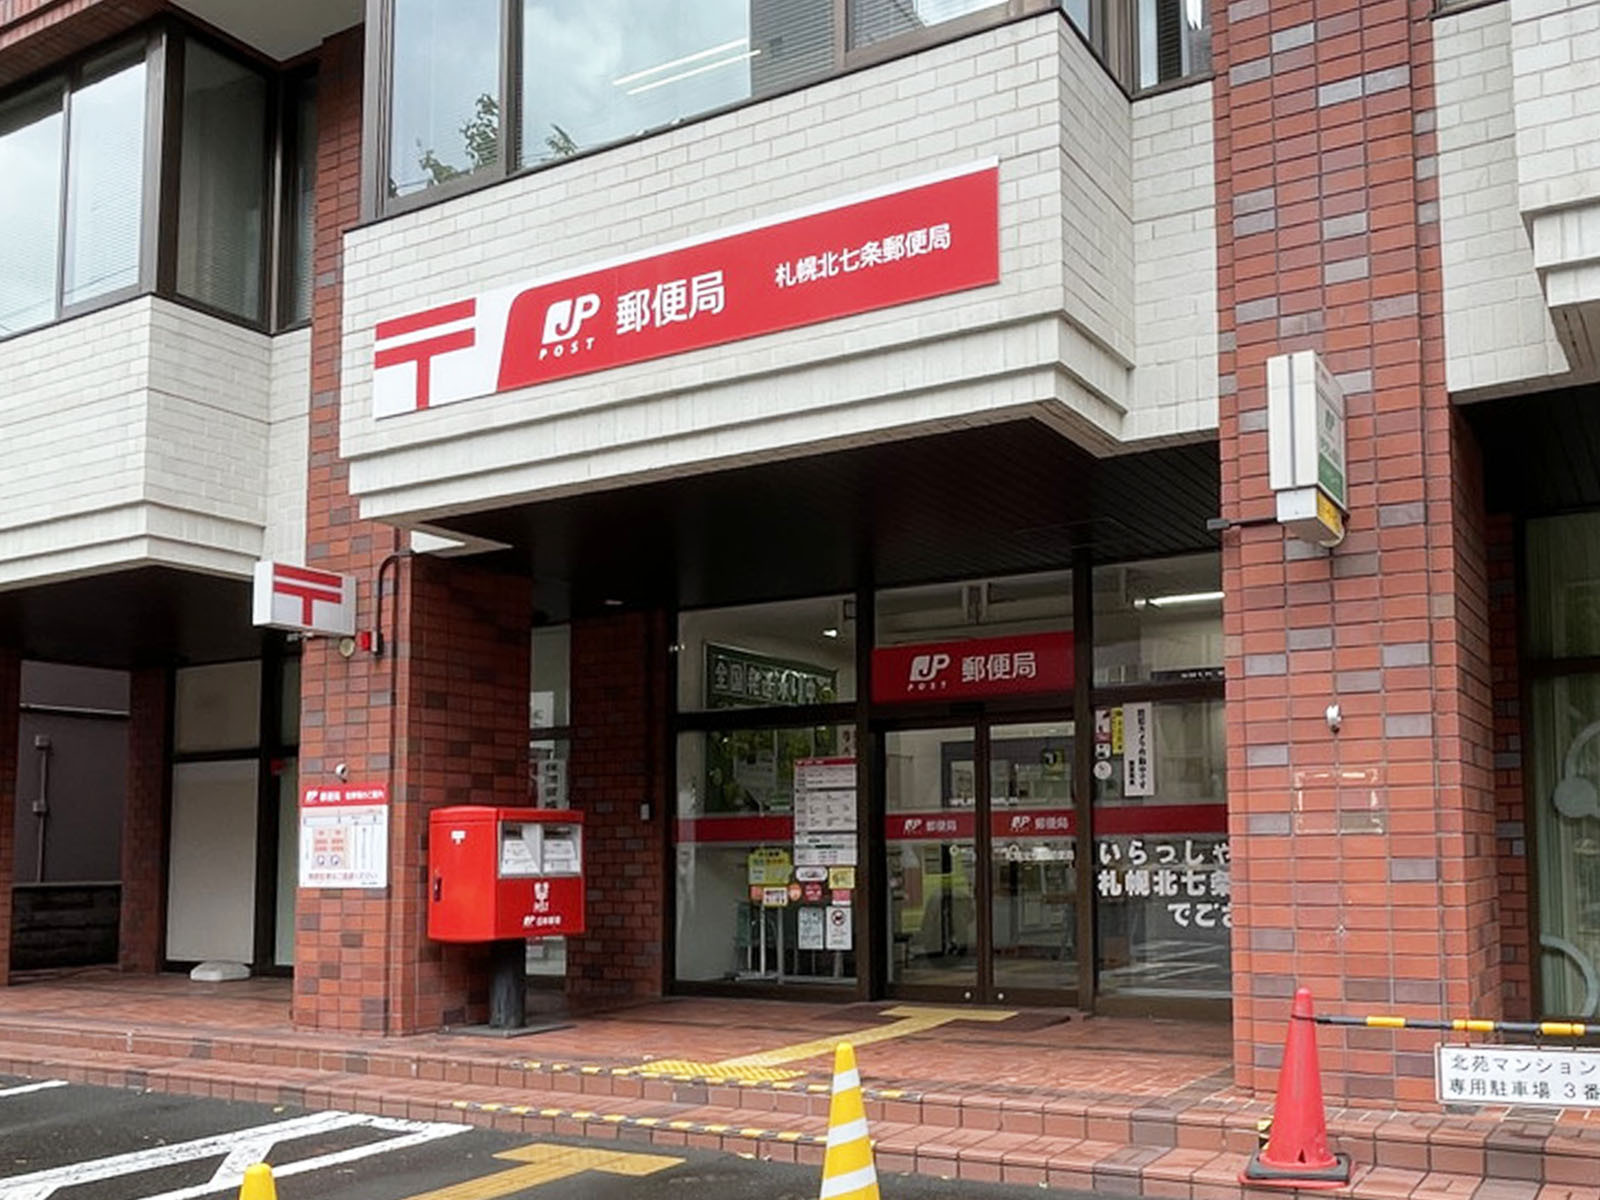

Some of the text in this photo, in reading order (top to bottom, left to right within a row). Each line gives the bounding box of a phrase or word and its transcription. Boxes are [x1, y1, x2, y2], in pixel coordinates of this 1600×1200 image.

[775, 223, 951, 288] 札幌北七条郵便局
[541, 271, 725, 345] JP 郵便局
[538, 337, 595, 361] POST
[962, 652, 1037, 683] 郵便局
[1451, 1054, 1597, 1076] 北苑マンション
[1450, 1078, 1550, 1099] 専用駐車場
